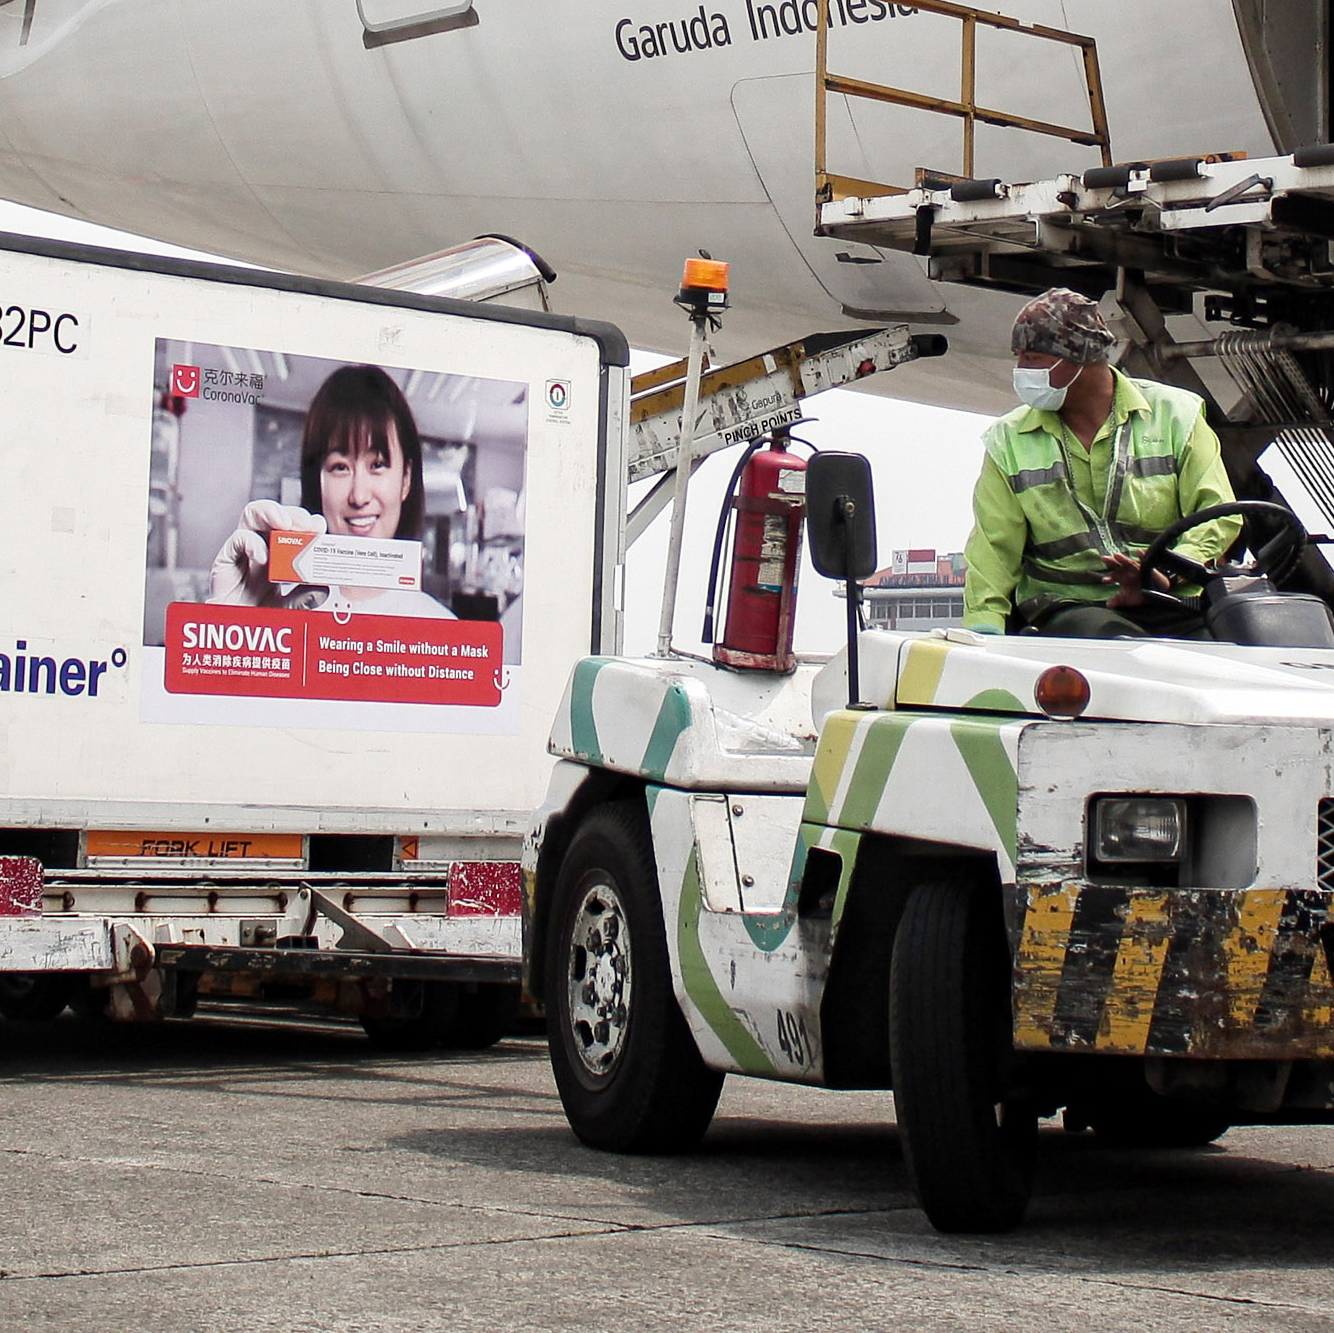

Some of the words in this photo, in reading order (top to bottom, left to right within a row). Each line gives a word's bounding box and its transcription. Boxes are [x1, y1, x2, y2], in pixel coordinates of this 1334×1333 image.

[614, 5, 732, 62] Garuda
[203, 368, 264, 390] 克尔来福
[202, 387, 260, 406] CoronaVac
[724, 423, 759, 445] PINCH
[761, 408, 802, 431] POINTS
[182, 622, 292, 654] SINOVAC
[319, 636, 364, 654] Wearing
[366, 643, 373, 652] a
[376, 639, 406, 654] Smile
[408, 641, 449, 656] without
[451, 647, 458, 656] a
[460, 644, 489, 658] Mask
[318, 660, 350, 676] Being
[352, 661, 383, 676] Close
[385, 663, 426, 678] without
[428, 665, 474, 680] Distance
[140, 839, 200, 857] FORK
[207, 840, 252, 858] LIFT
